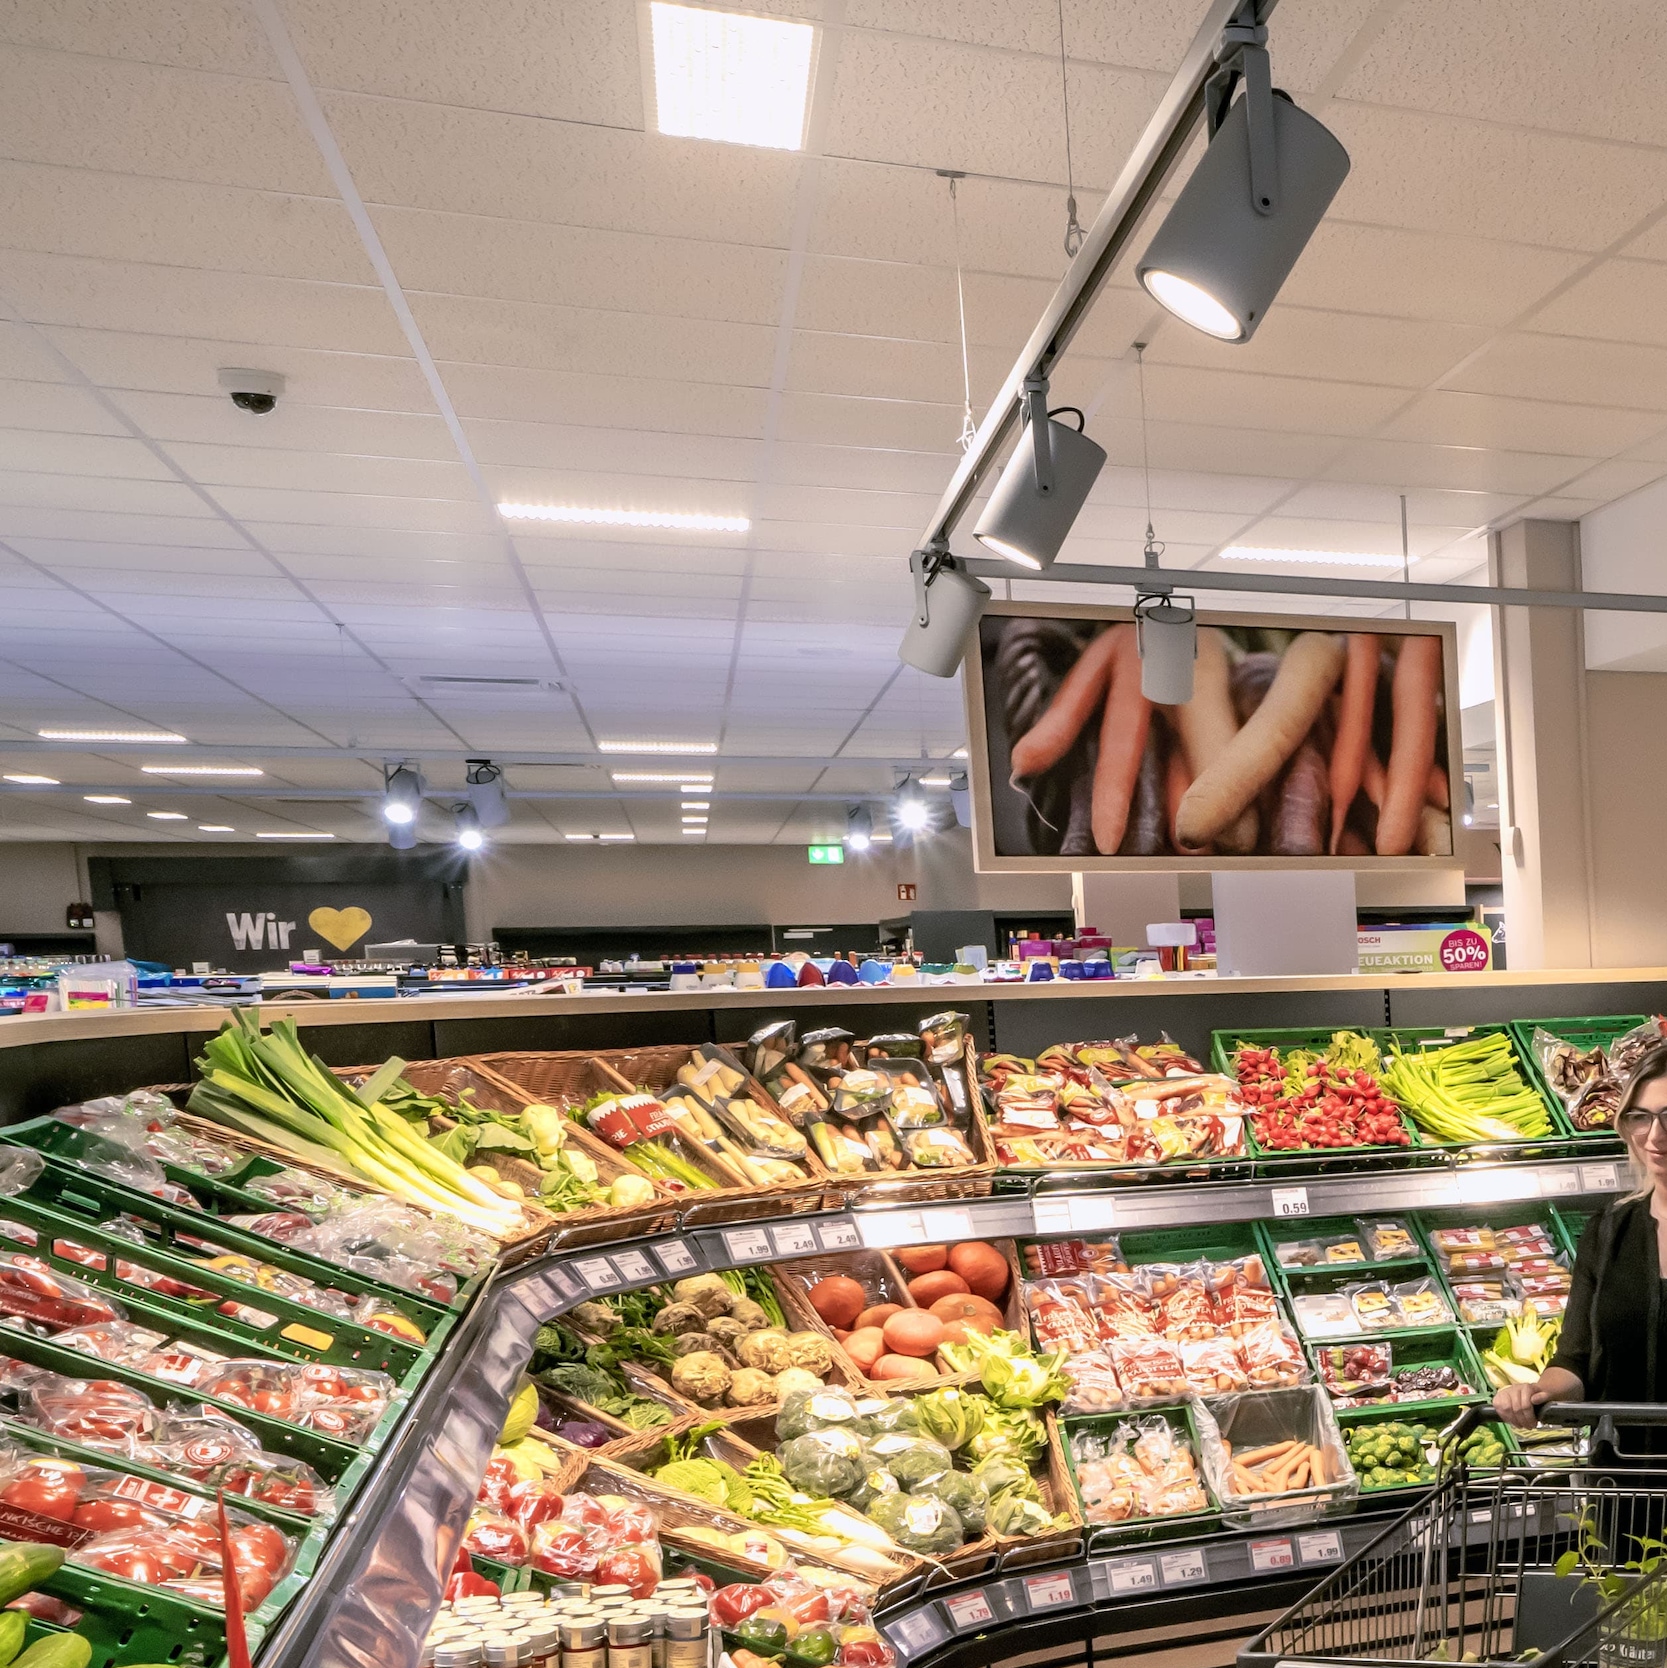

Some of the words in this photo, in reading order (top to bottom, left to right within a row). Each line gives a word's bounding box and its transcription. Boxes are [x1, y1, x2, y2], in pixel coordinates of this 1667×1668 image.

[226, 912, 296, 950] Wir
[1448, 940, 1463, 948] BIS
[1466, 938, 1478, 946] ZU
[1359, 955, 1433, 966] EUEAKTION
[1443, 945, 1486, 964] 50%
[1450, 961, 1482, 971] SPAREN!
[1282, 1203, 1307, 1214] 0.59
[793, 1239, 815, 1251] 2.49
[836, 1233, 857, 1245] 2.49
[748, 1245, 770, 1256] 1.99
[0, 1511, 65, 1537] NKISCHE
[1318, 1547, 1338, 1558] 1.99
[1180, 1566, 1203, 1578] 1.29
[1131, 1574, 1153, 1586] 1.49
[1049, 1590, 1071, 1602] 1.19
[969, 1607, 989, 1620] 1.79
